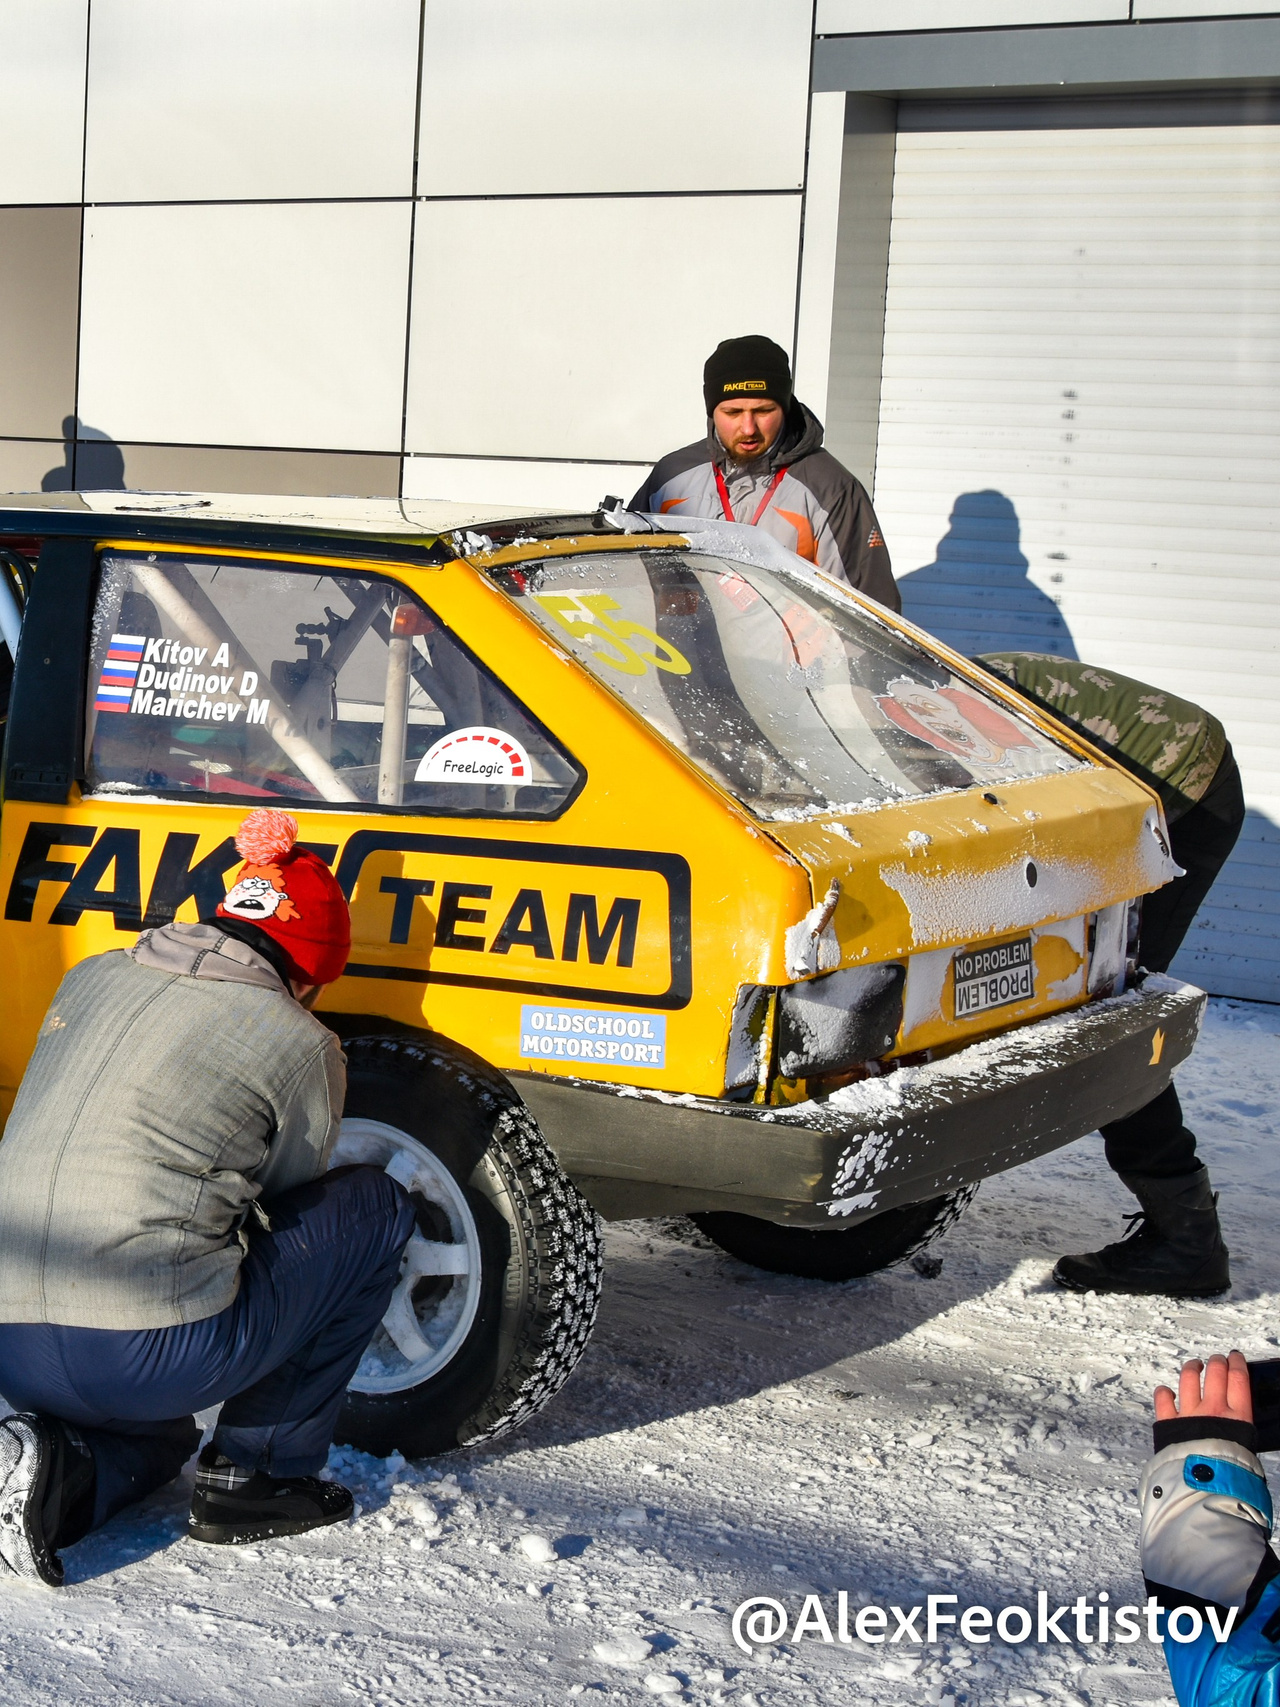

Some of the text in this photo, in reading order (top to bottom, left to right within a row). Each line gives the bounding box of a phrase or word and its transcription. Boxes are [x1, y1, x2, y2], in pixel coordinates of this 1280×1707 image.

[723, 382, 745, 392] FAKE
[531, 593, 692, 676] 55
[144, 638, 230, 668] Kitov A
[138, 664, 258, 697] Dudinov D
[131, 689, 270, 725] Marichev M
[443, 760, 504, 778] FreeLogic
[4, 821, 641, 968] FAK TEAM
[955, 943, 1029, 979] NO PROBLEM
[958, 969, 1029, 1012] PROBLEM
[530, 1011, 655, 1039] OLDSCHOOL
[522, 1034, 663, 1063] MOTORSPORT
